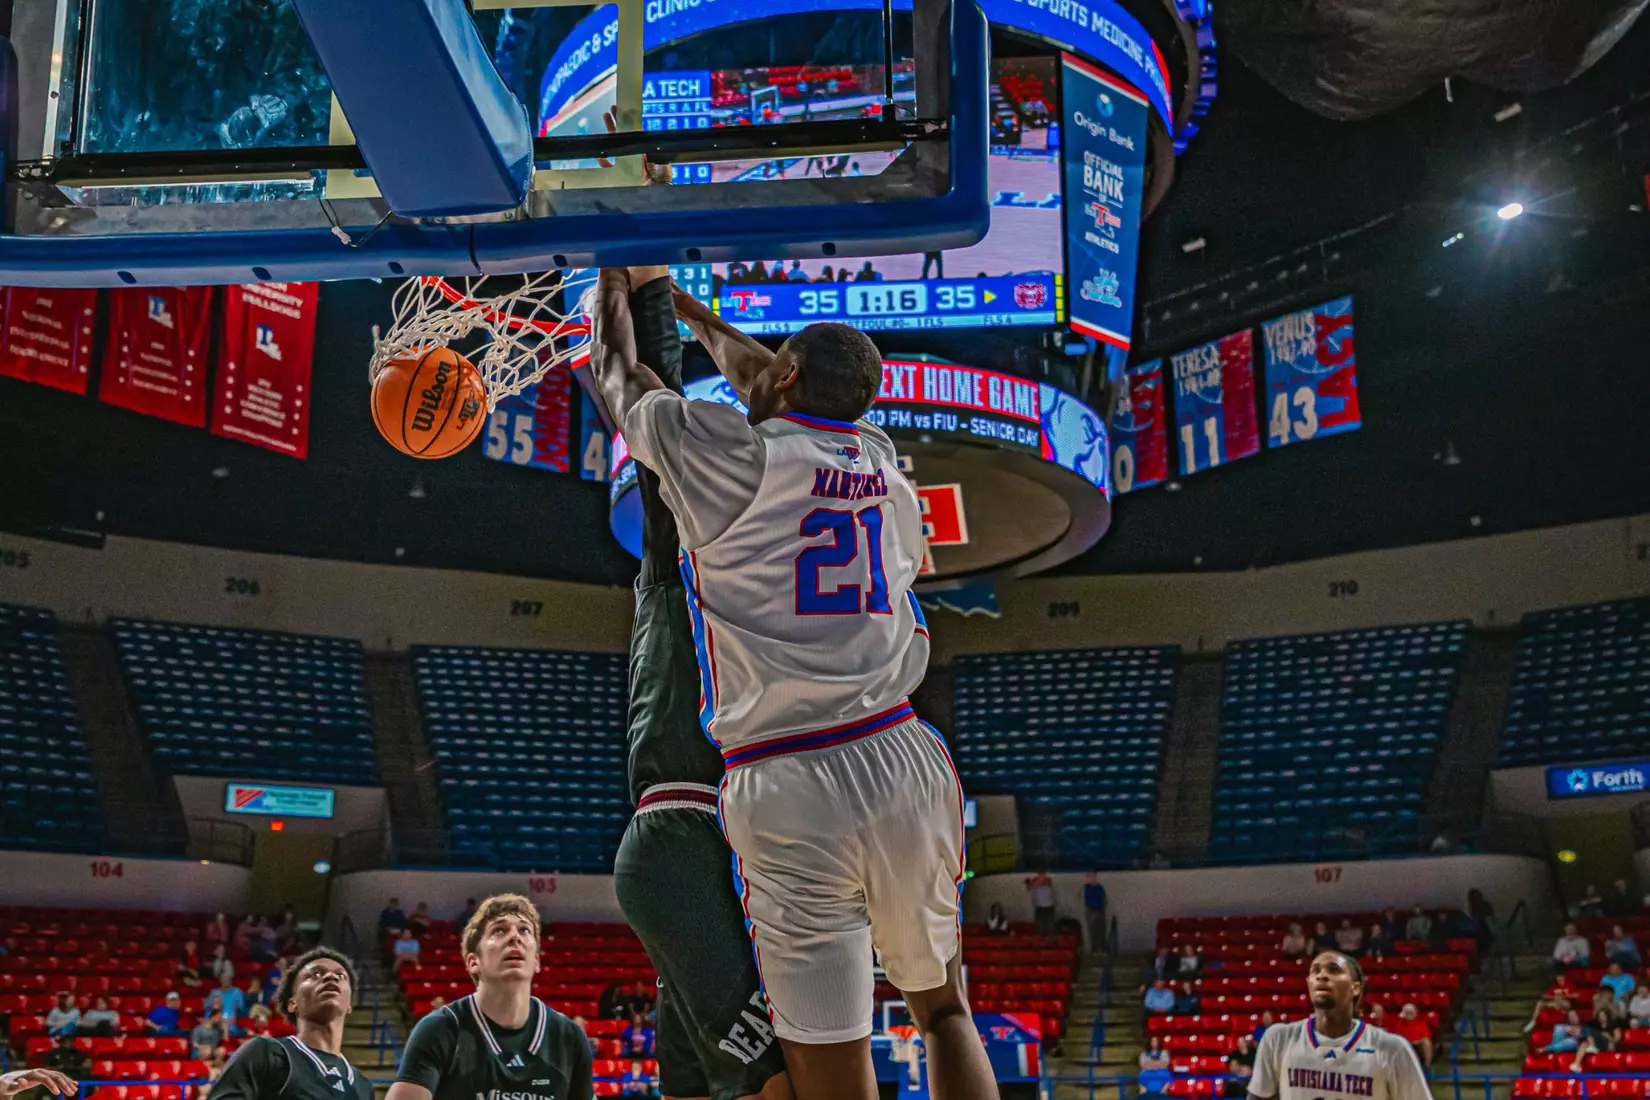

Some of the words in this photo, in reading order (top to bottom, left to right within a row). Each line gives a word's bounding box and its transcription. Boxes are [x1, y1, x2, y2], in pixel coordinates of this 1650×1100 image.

[658, 79, 700, 97] TECH
[1074, 111, 1107, 137] Origin
[1109, 127, 1135, 152] Bank
[1083, 164, 1124, 202] BANK
[798, 290, 839, 315] 35
[858, 289, 917, 313] 1:16
[935, 285, 976, 310] 35
[1264, 311, 1316, 349] VENUS
[411, 361, 452, 432] Wilson
[879, 364, 917, 400] EXT
[922, 366, 984, 408] HOME
[987, 376, 1040, 422] GAME
[888, 409, 912, 428] PM
[932, 411, 958, 432] FIU
[970, 418, 1015, 444] SENIOR
[1270, 386, 1318, 445] 43
[487, 410, 533, 466] 55
[1180, 416, 1220, 475] 11
[794, 504, 894, 616] 21
[224, 577, 262, 597] 206
[90, 861, 124, 878] 104
[1314, 866, 1343, 884] 107
[1288, 1067, 1342, 1093] LOUISIANA
[1345, 1073, 1375, 1097] TECH
